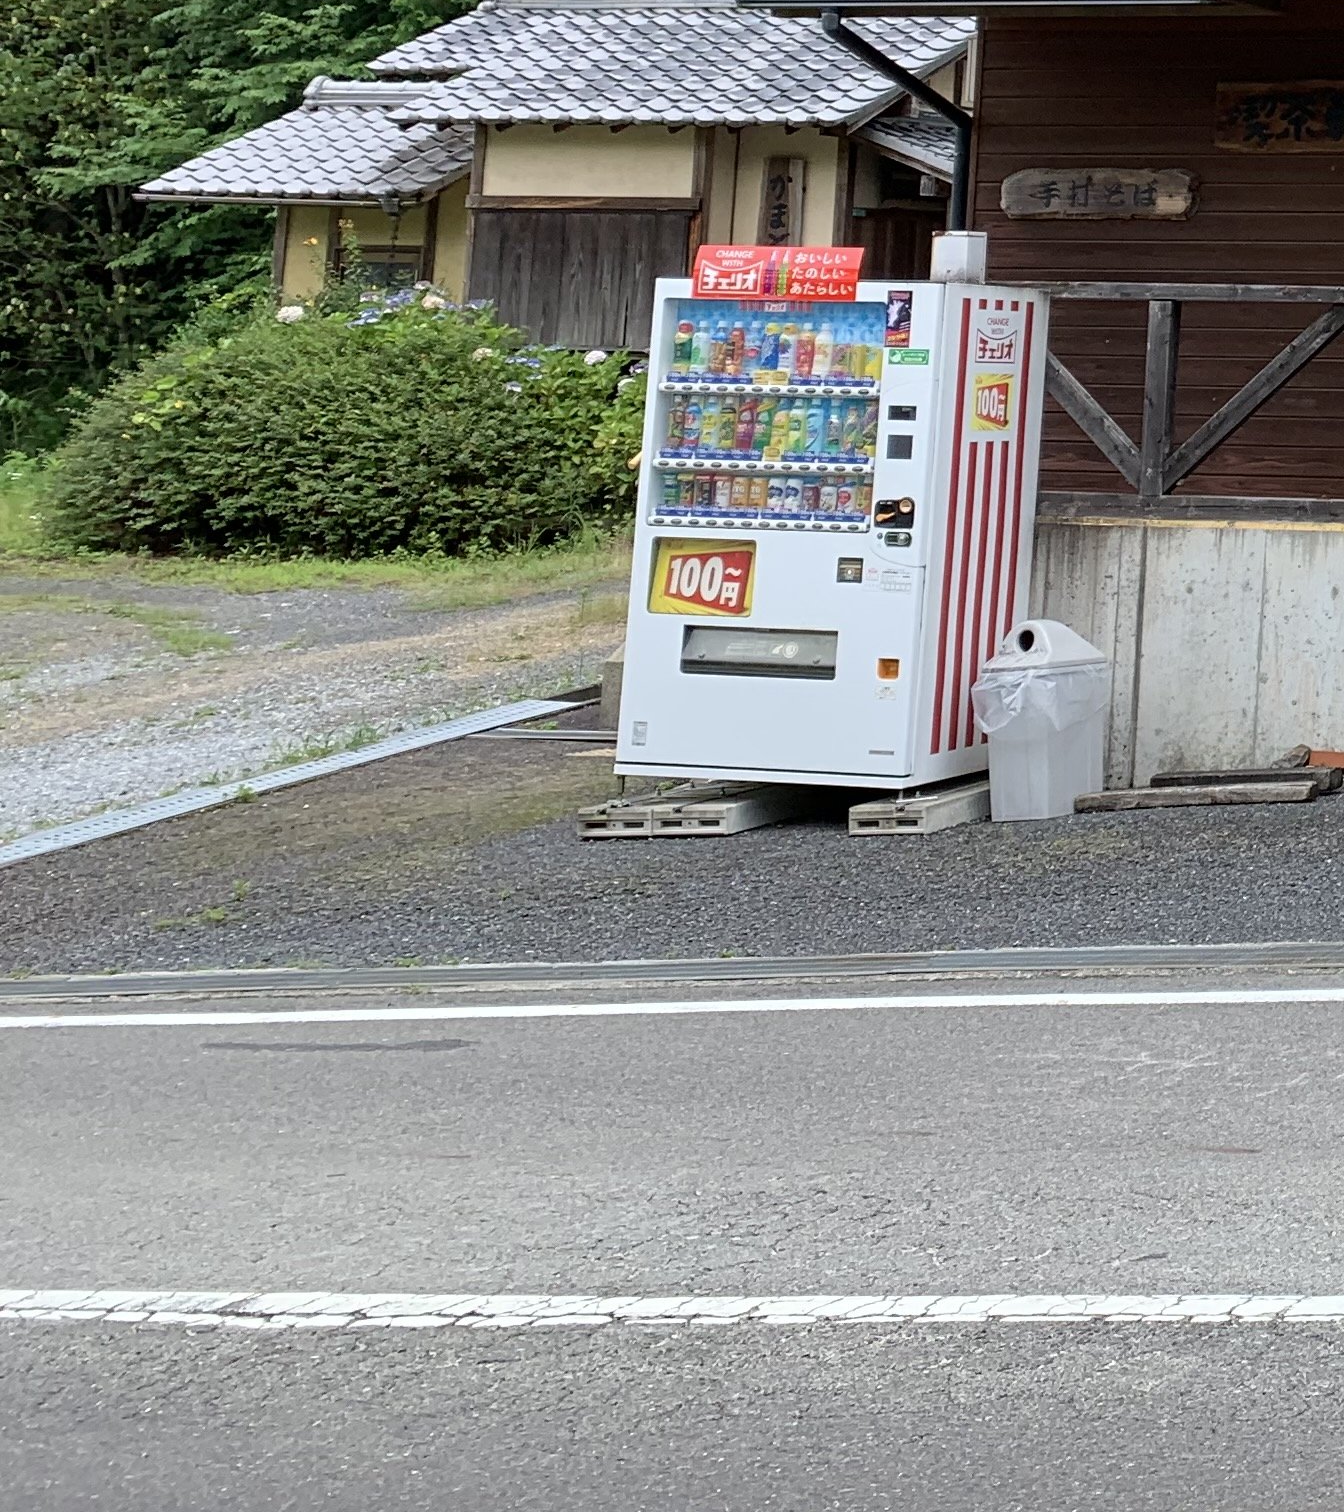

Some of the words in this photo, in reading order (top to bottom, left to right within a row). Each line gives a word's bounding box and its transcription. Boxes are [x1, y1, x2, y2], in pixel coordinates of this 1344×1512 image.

[715, 250, 755, 259] CHANGE
[794, 251, 848, 265] おいしい
[721, 259, 744, 267] WITH
[702, 268, 758, 290] チェリオ
[791, 267, 847, 280] たのしい
[789, 282, 854, 296] あたらしい
[987, 317, 1010, 326] CHANGE
[978, 337, 1014, 360] チェリオ
